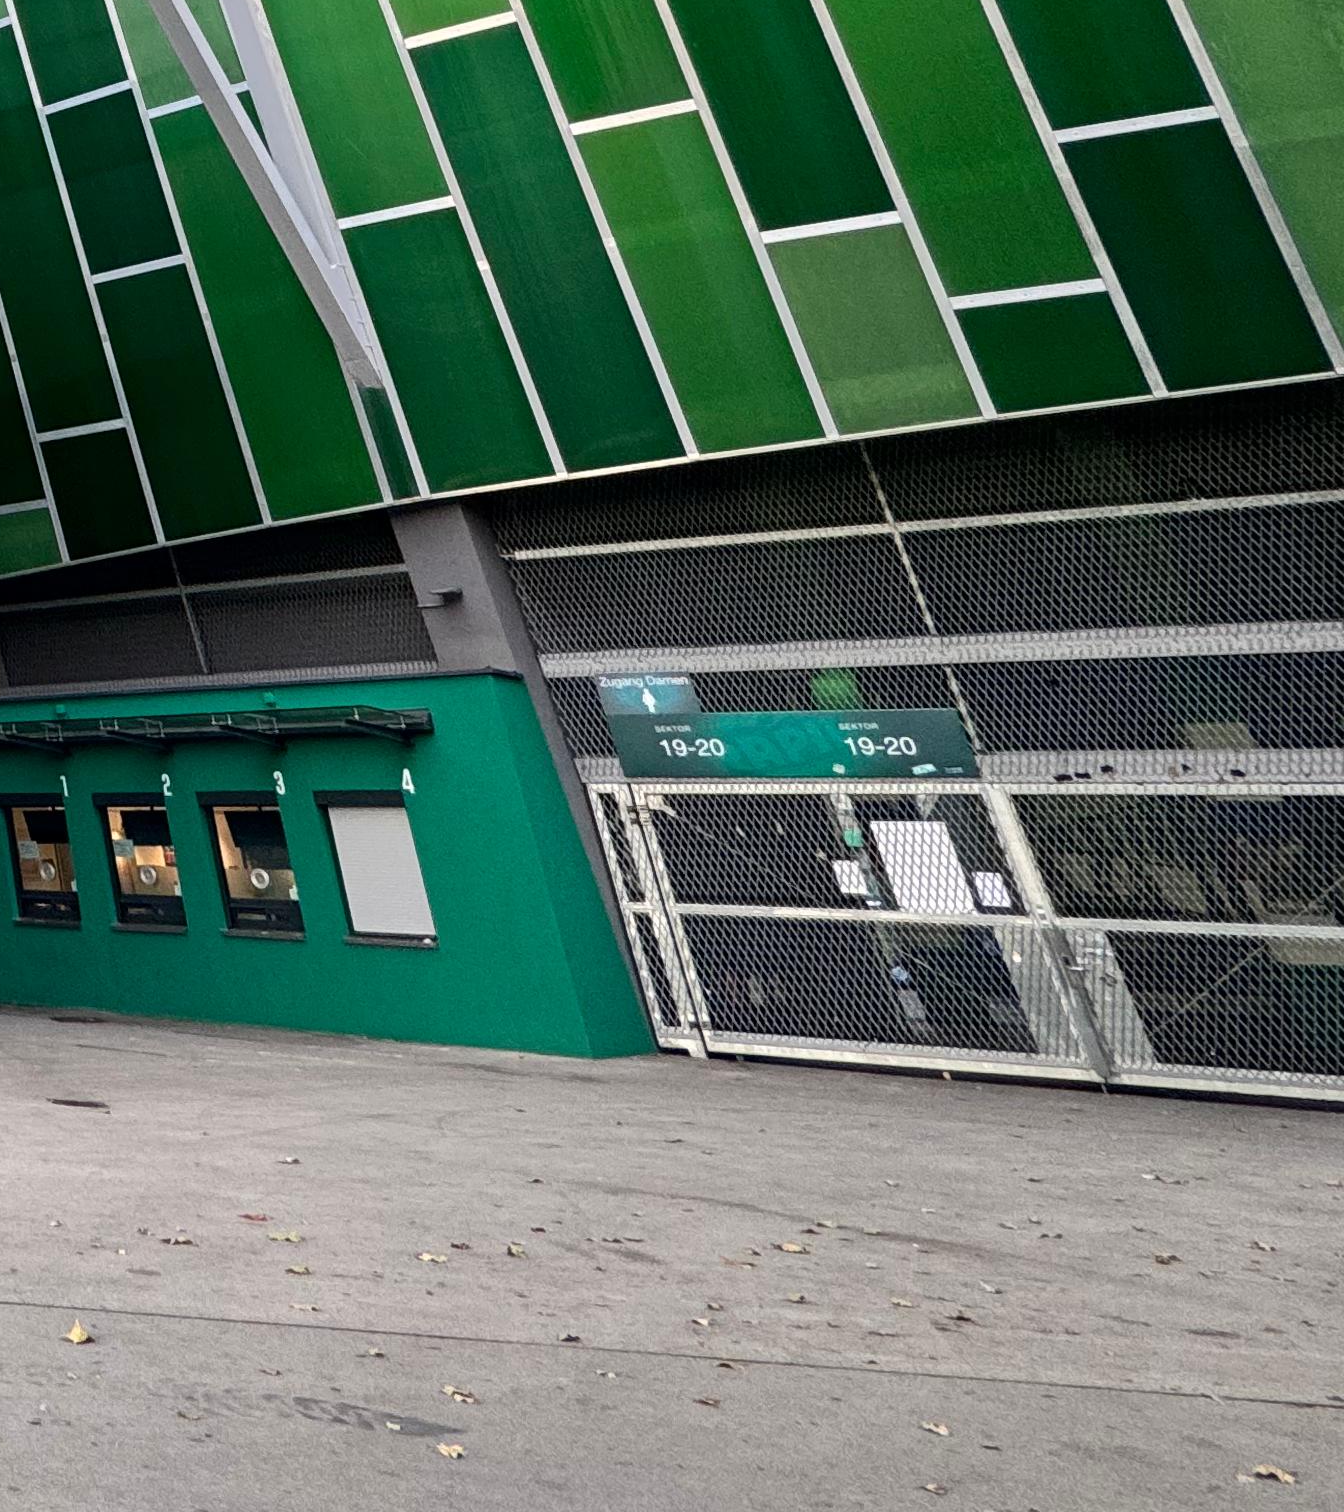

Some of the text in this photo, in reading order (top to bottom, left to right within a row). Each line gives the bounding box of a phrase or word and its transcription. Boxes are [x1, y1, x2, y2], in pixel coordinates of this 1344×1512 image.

[598, 674, 689, 689] Zugang Damen
[654, 724, 691, 734] SEKTOR
[838, 722, 880, 731] SEKTOR
[659, 738, 726, 758] 19-20
[844, 736, 918, 757] 19-20
[60, 774, 69, 797] 1
[161, 773, 173, 797] 2
[273, 771, 286, 796] 3
[401, 768, 416, 795] 4
